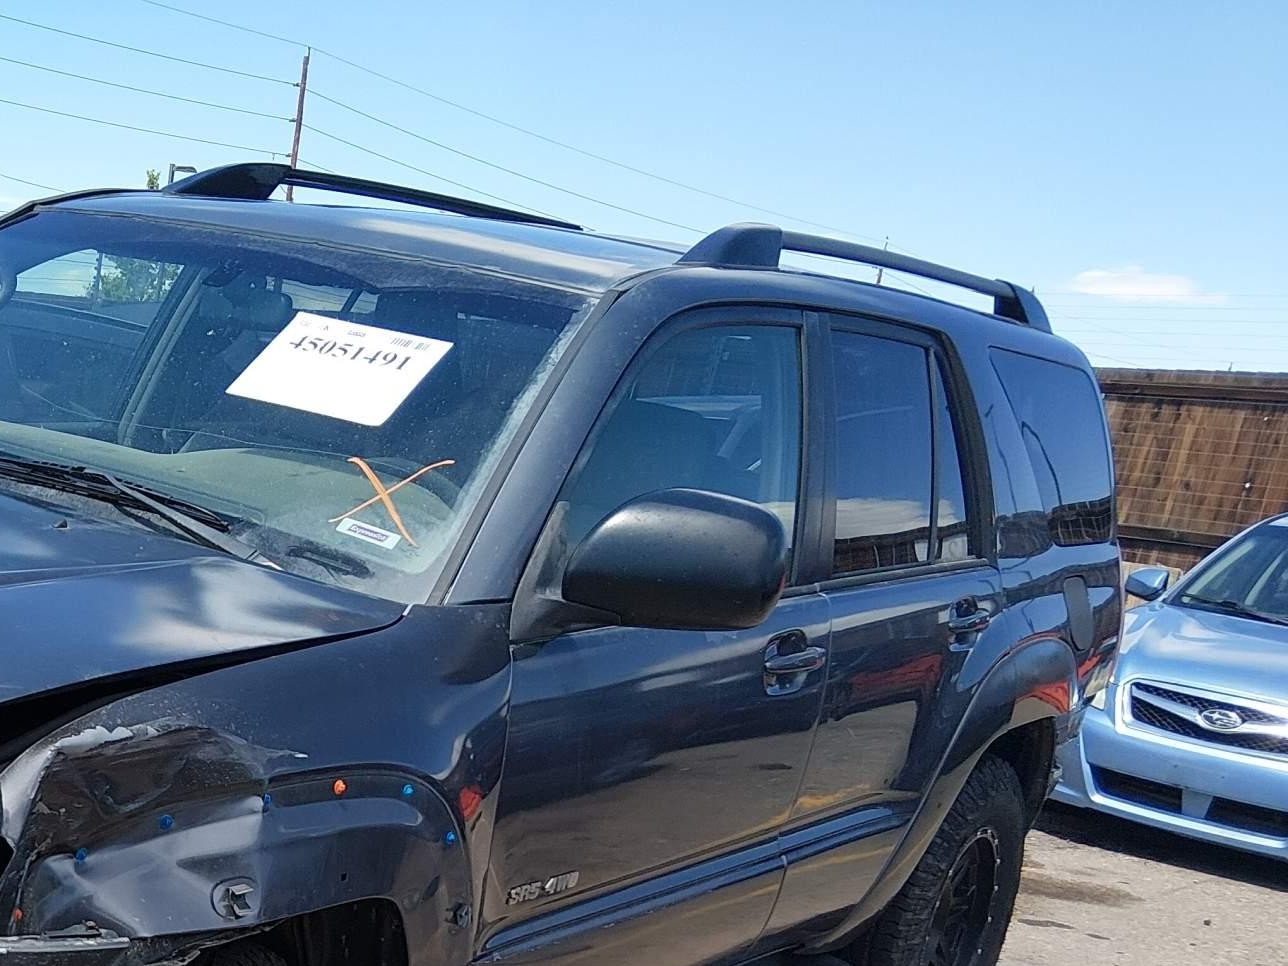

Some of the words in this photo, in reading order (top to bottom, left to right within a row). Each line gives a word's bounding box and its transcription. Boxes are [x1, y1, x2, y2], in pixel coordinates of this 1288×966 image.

[289, 335, 412, 370] 45051491
[507, 881, 542, 905] SR5
[544, 871, 579, 895] 4WD
